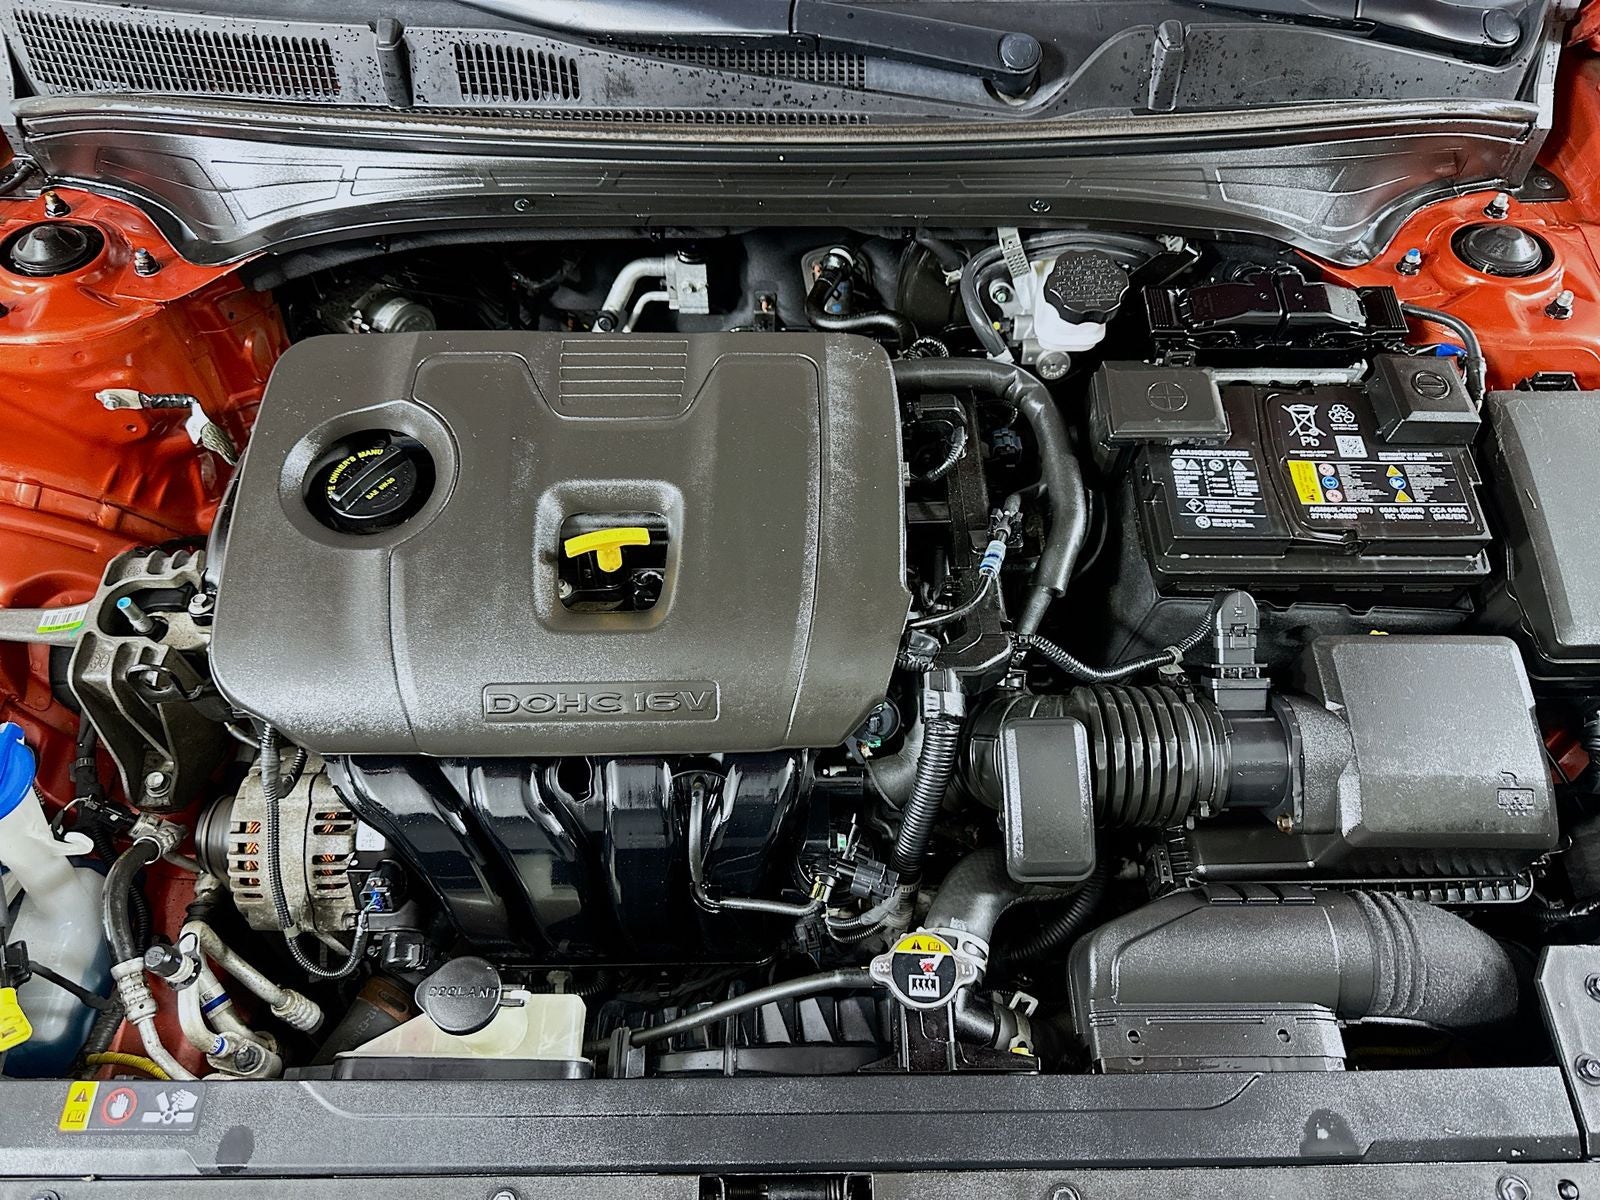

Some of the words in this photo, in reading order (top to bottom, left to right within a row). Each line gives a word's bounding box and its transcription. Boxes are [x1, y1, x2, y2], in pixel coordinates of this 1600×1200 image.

[1300, 436, 1320, 447] Pb
[328, 455, 357, 484] OWNER'S
[357, 448, 384, 459] MANU
[1429, 506, 1447, 514] CCA
[487, 691, 622, 714] DOHC
[634, 690, 714, 712] 16V
[873, 961, 890, 973] HCC
[428, 986, 499, 999] COOLANT
